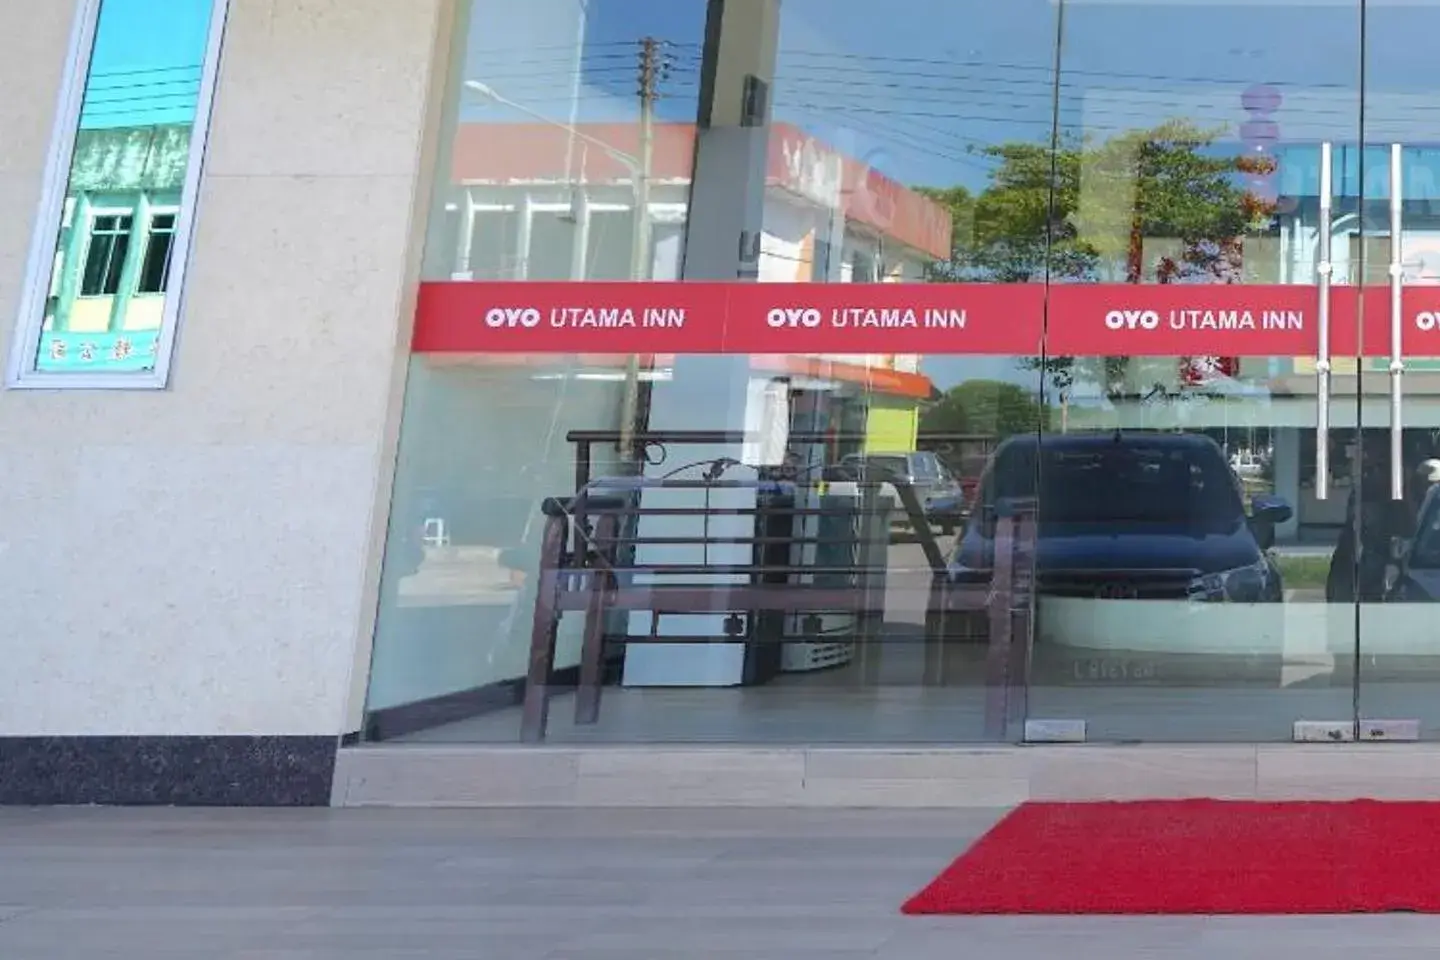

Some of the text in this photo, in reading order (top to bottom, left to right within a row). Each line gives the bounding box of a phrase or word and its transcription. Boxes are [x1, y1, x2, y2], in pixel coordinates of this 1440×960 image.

[485, 308, 686, 327] OYO UTAMA INN
[767, 308, 967, 328] OYO UTAMA INN
[1105, 310, 1304, 329] OYO UTAMA INN
